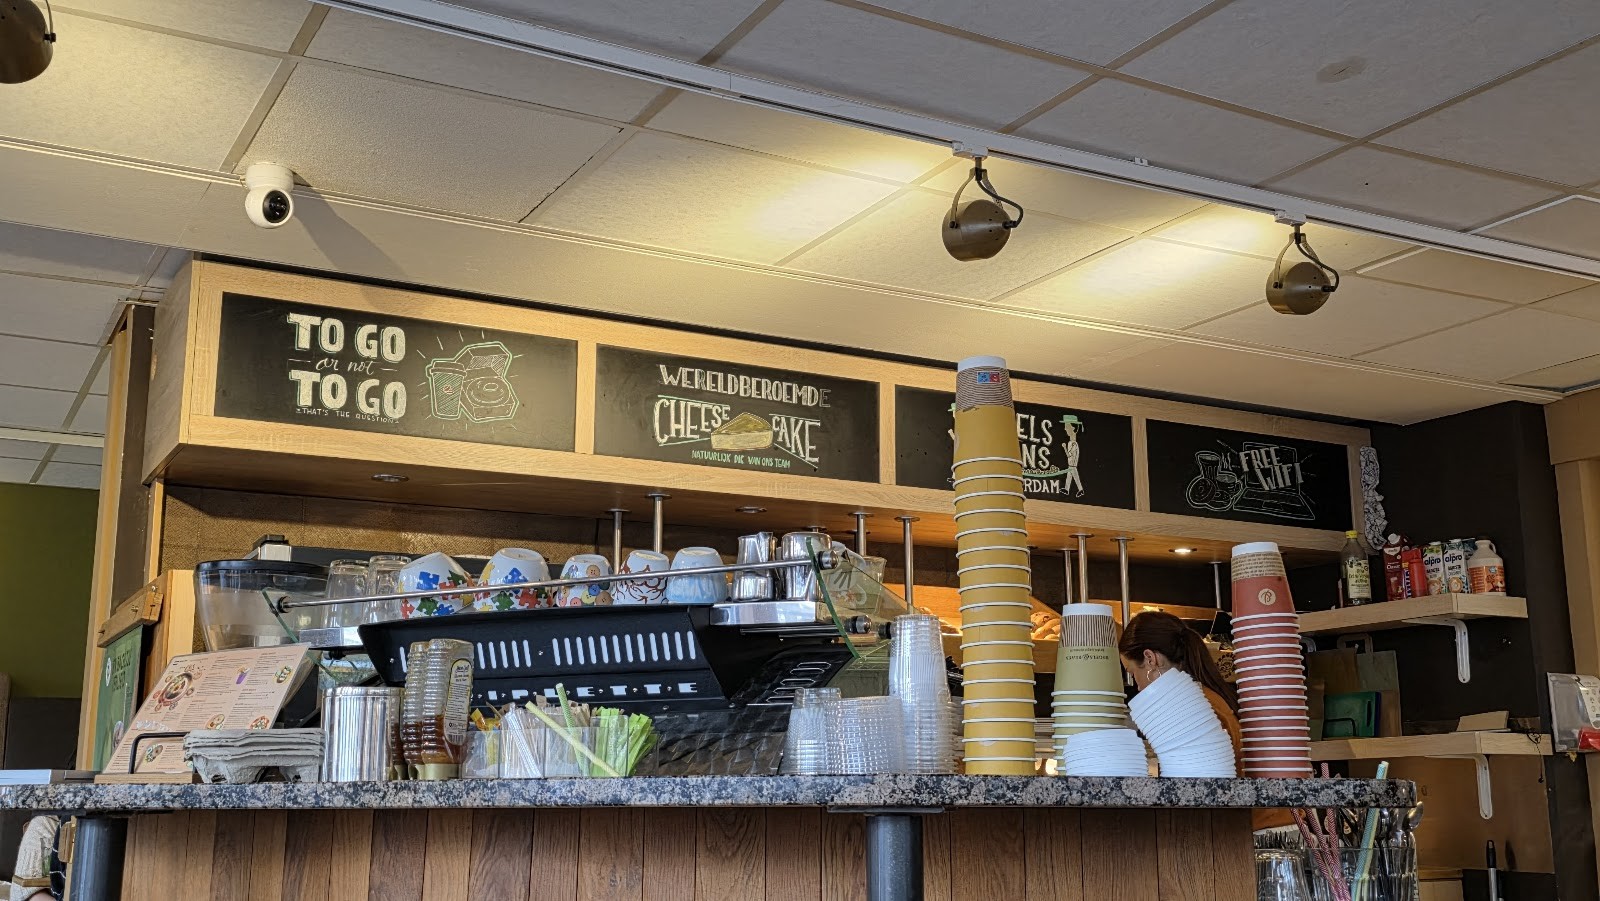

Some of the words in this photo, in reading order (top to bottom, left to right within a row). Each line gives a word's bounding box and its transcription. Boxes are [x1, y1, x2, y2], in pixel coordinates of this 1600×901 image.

[287, 312, 344, 353] TO
[355, 324, 406, 363] GO
[316, 358, 338, 371] or
[348, 361, 375, 376] not
[289, 369, 347, 410] TO
[356, 378, 407, 419] GO
[659, 364, 832, 408] WERELDBEROEMDE
[336, 410, 350, 418] THE
[653, 398, 731, 443] CHEESE
[772, 415, 821, 463] CAKE
[1016, 412, 1053, 447] ELS
[691, 450, 732, 463] NATUURLIJK
[747, 456, 761, 466] VAN
[761, 457, 774, 467] ONS
[775, 458, 791, 469] TEAM
[1239, 446, 1283, 472] FREE
[1254, 462, 1304, 491] WIFI
[1424, 556, 1442, 567] alpro
[1445, 553, 1463, 564] alpro
